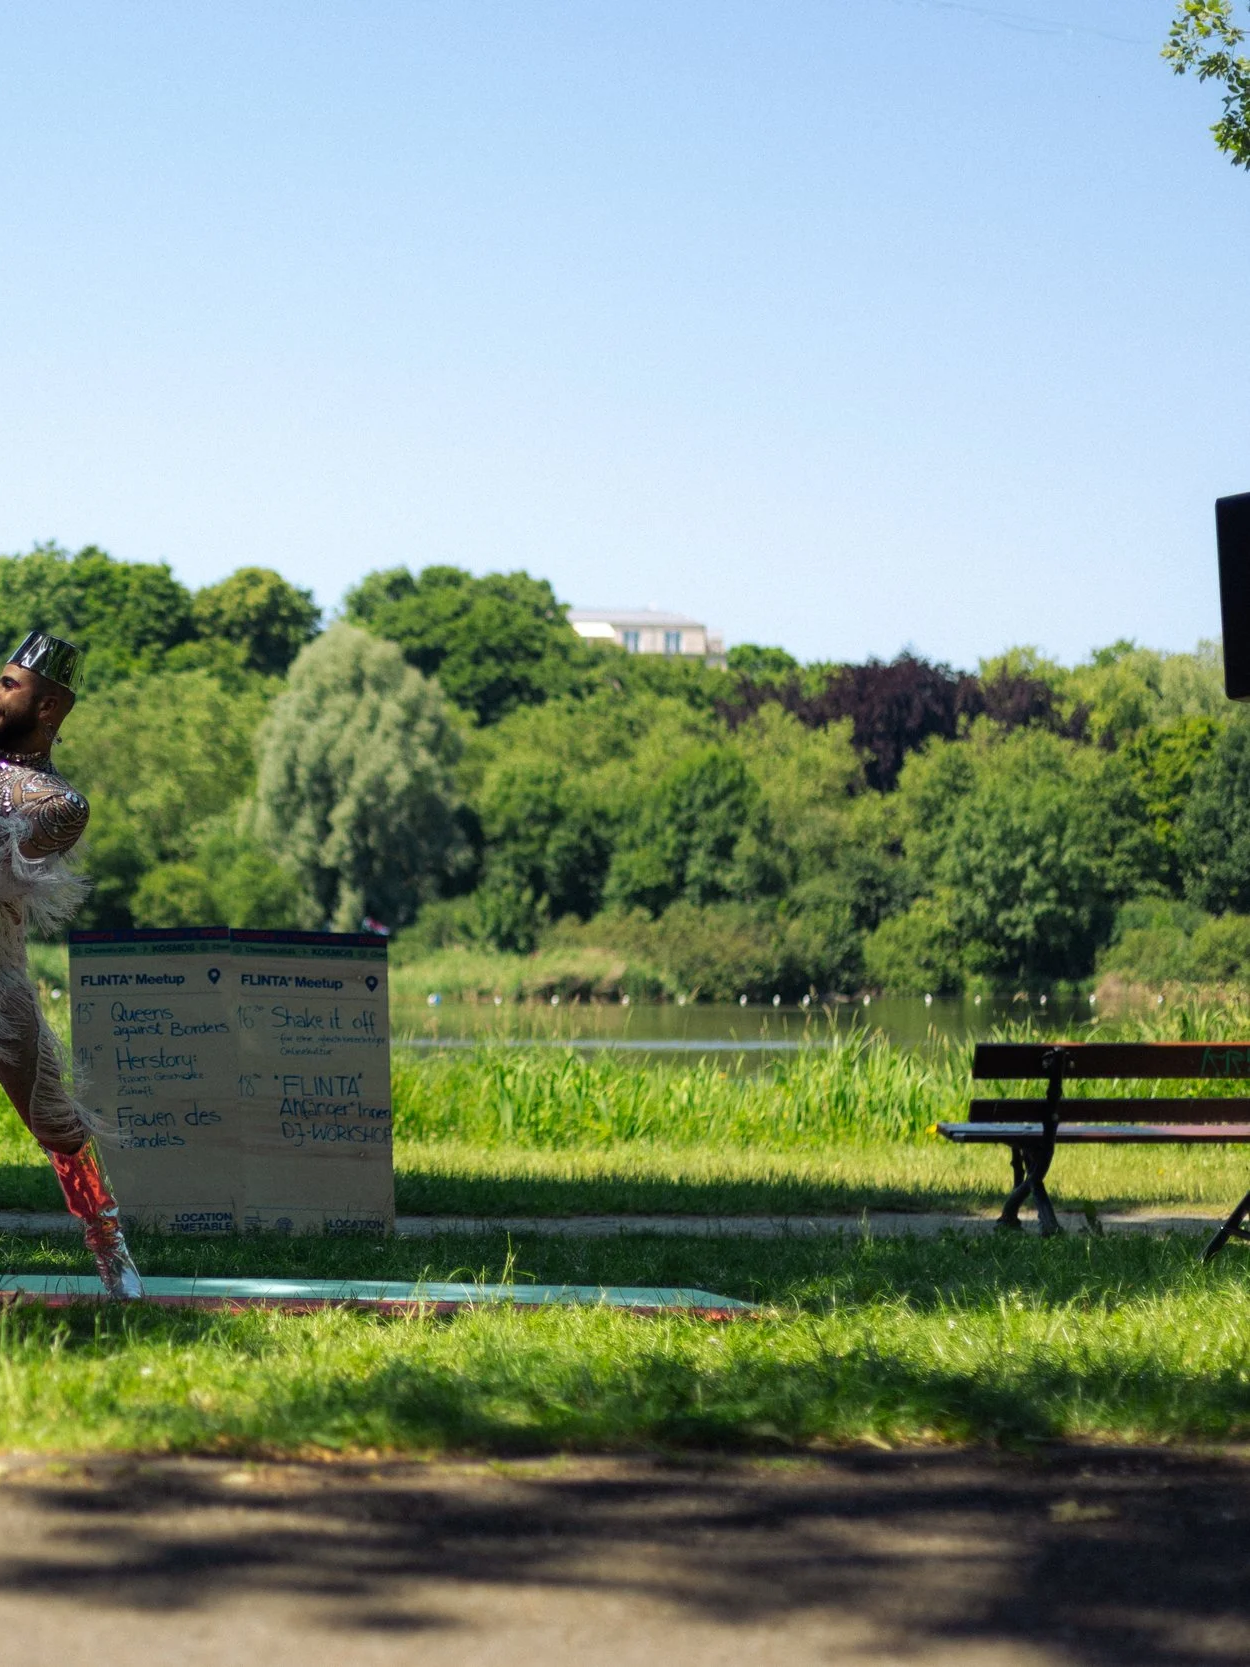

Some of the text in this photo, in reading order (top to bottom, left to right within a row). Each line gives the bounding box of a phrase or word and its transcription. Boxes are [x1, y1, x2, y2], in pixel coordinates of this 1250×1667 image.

[135, 973, 186, 986] Meetup
[294, 976, 344, 991] Meetup
[110, 1001, 174, 1023] Queens
[271, 1006, 377, 1035] Shake it off
[113, 1021, 230, 1041] against Borders
[115, 1047, 198, 1078] Herstory:
[117, 1106, 177, 1128] Frauen
[184, 1101, 222, 1126] des
[174, 1211, 233, 1222] LOCATION
[327, 1219, 385, 1230] LOCATION
[169, 1221, 232, 1233] TIMETABLE
